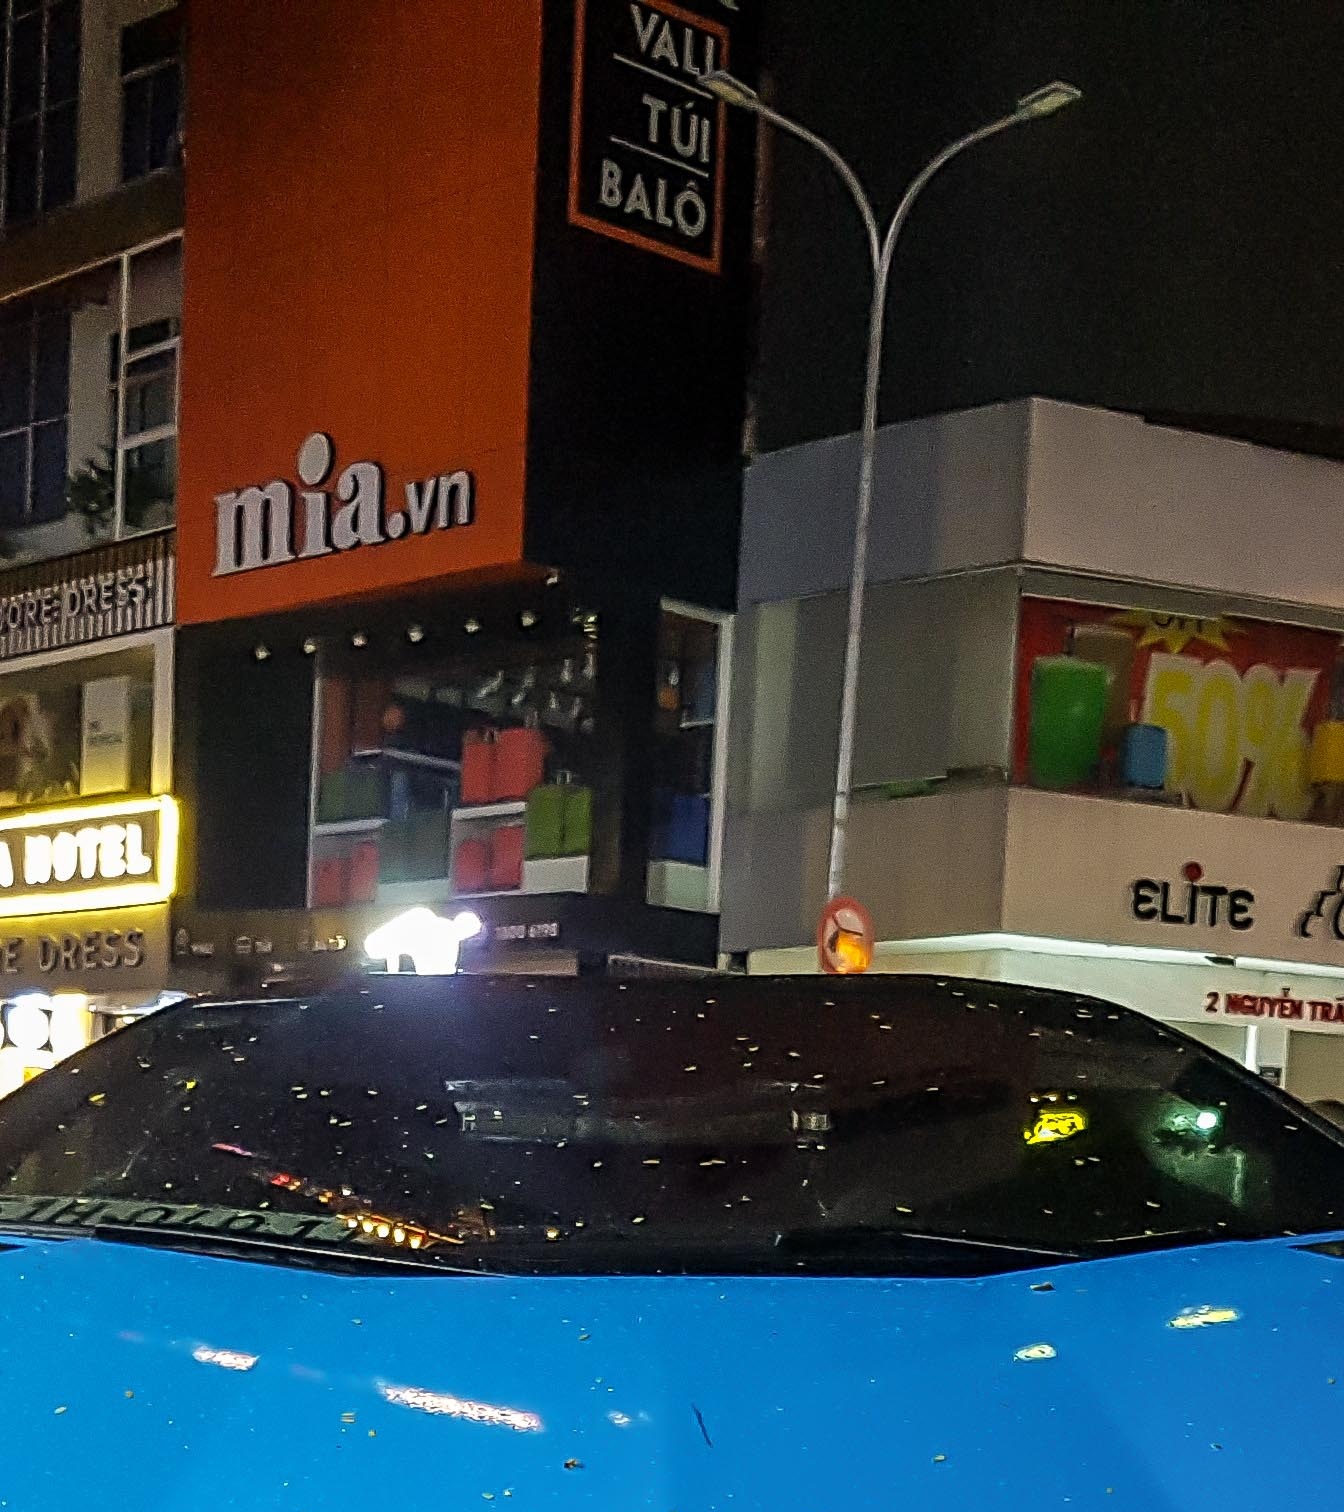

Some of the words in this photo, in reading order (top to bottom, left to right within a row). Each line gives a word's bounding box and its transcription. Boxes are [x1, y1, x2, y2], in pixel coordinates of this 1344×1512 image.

[630, 3, 715, 77] VALI
[642, 93, 709, 162] TÚI
[600, 158, 706, 237] BALÔ
[211, 432, 470, 577] mia.vn
[64, 574, 149, 618] DRESS
[24, 823, 152, 885] HOTEL
[38, 927, 146, 973] DRESS
[1205, 991, 1220, 1013] 2
